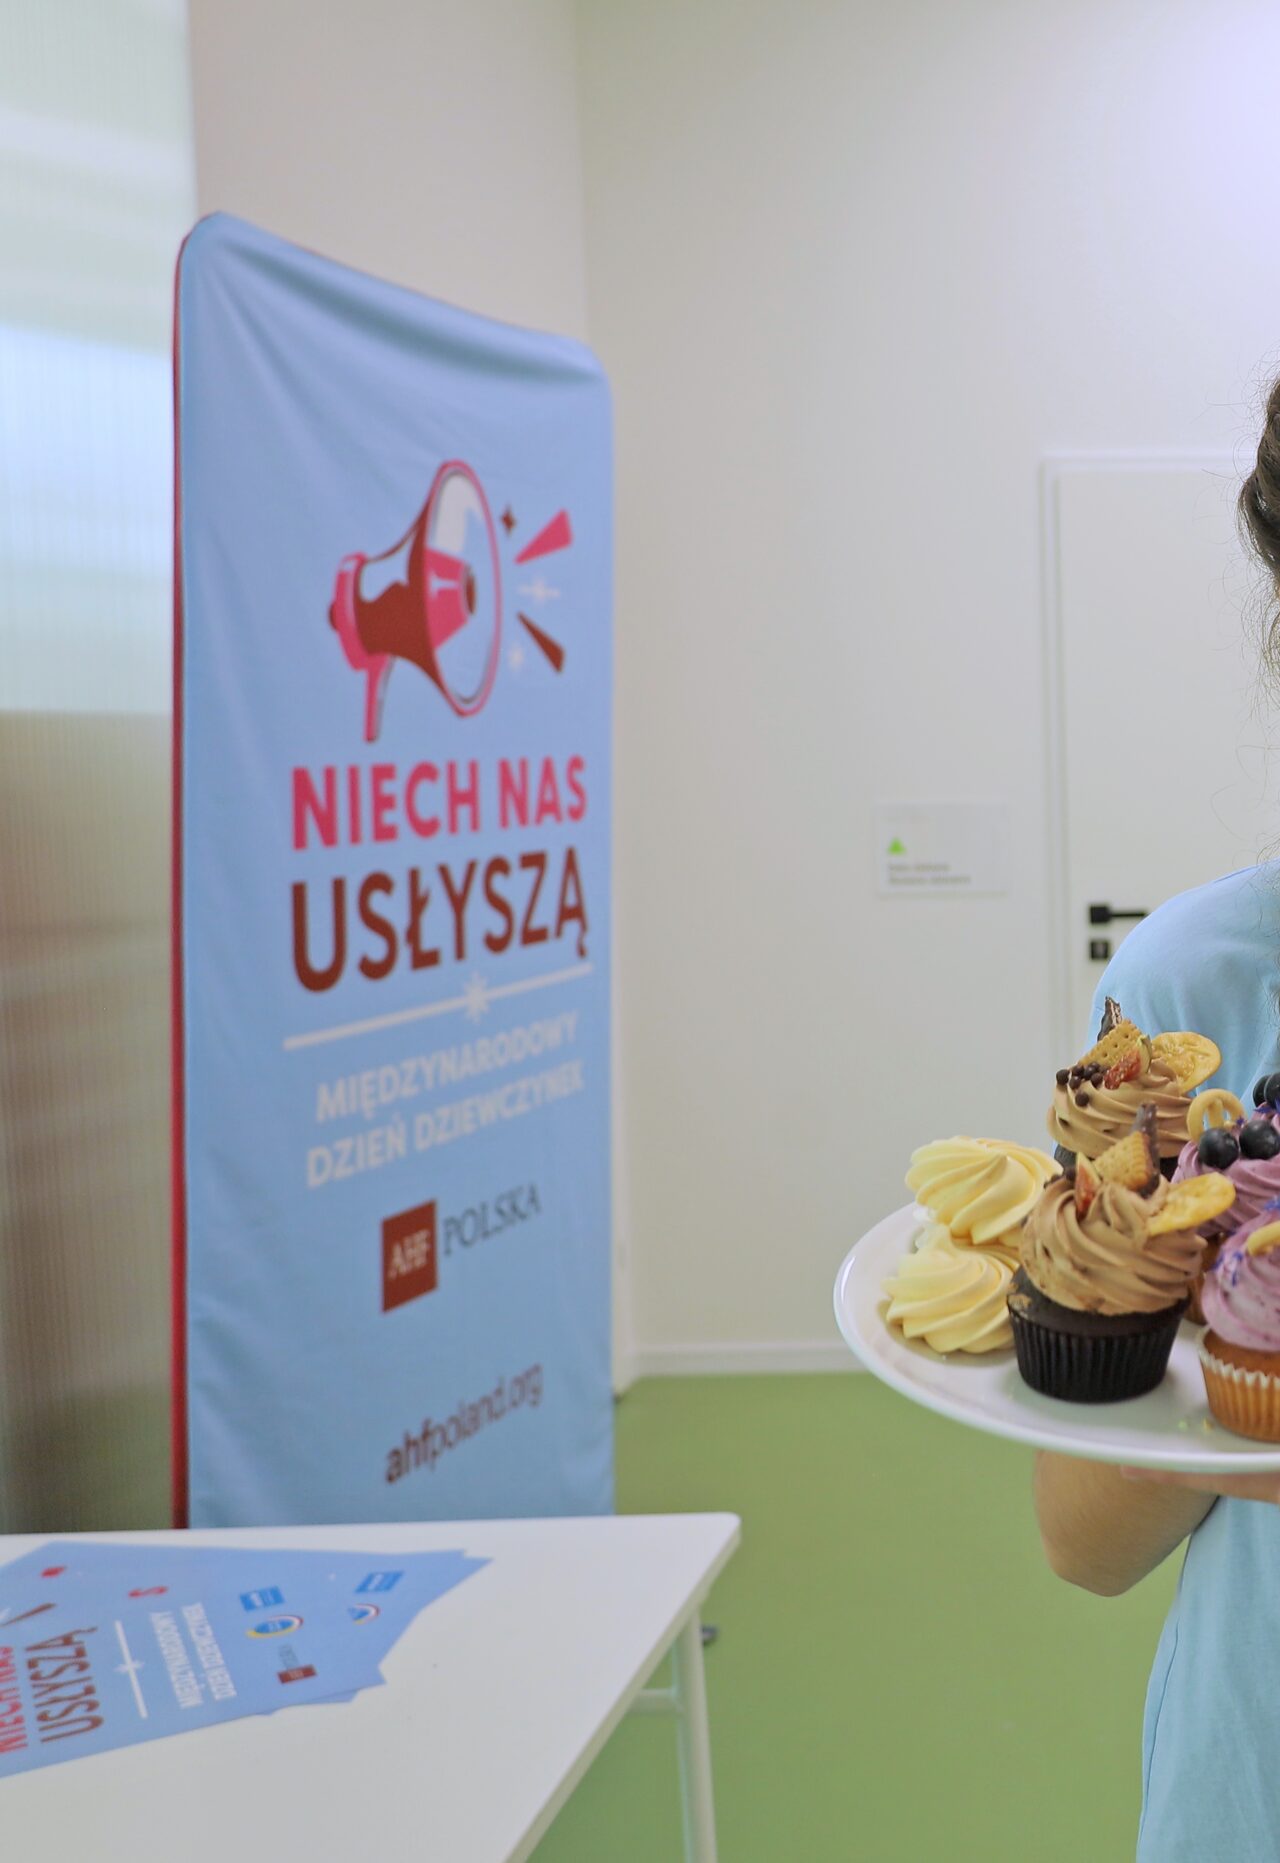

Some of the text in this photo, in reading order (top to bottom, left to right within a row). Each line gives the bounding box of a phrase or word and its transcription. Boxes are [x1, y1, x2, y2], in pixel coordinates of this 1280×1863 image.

[292, 755, 588, 851] NIECH NAS
[291, 846, 589, 993] USŁYSZĄ
[307, 1058, 584, 1188] DZIEŃ DZIEWCZYNEK
[316, 1009, 579, 1123] MIĘDZYNARODOWY
[388, 1181, 541, 1280] AHF POLSKA
[386, 1362, 543, 1484] ahfpoland.org
[25, 1626, 103, 1744] USŁYSZĄ
